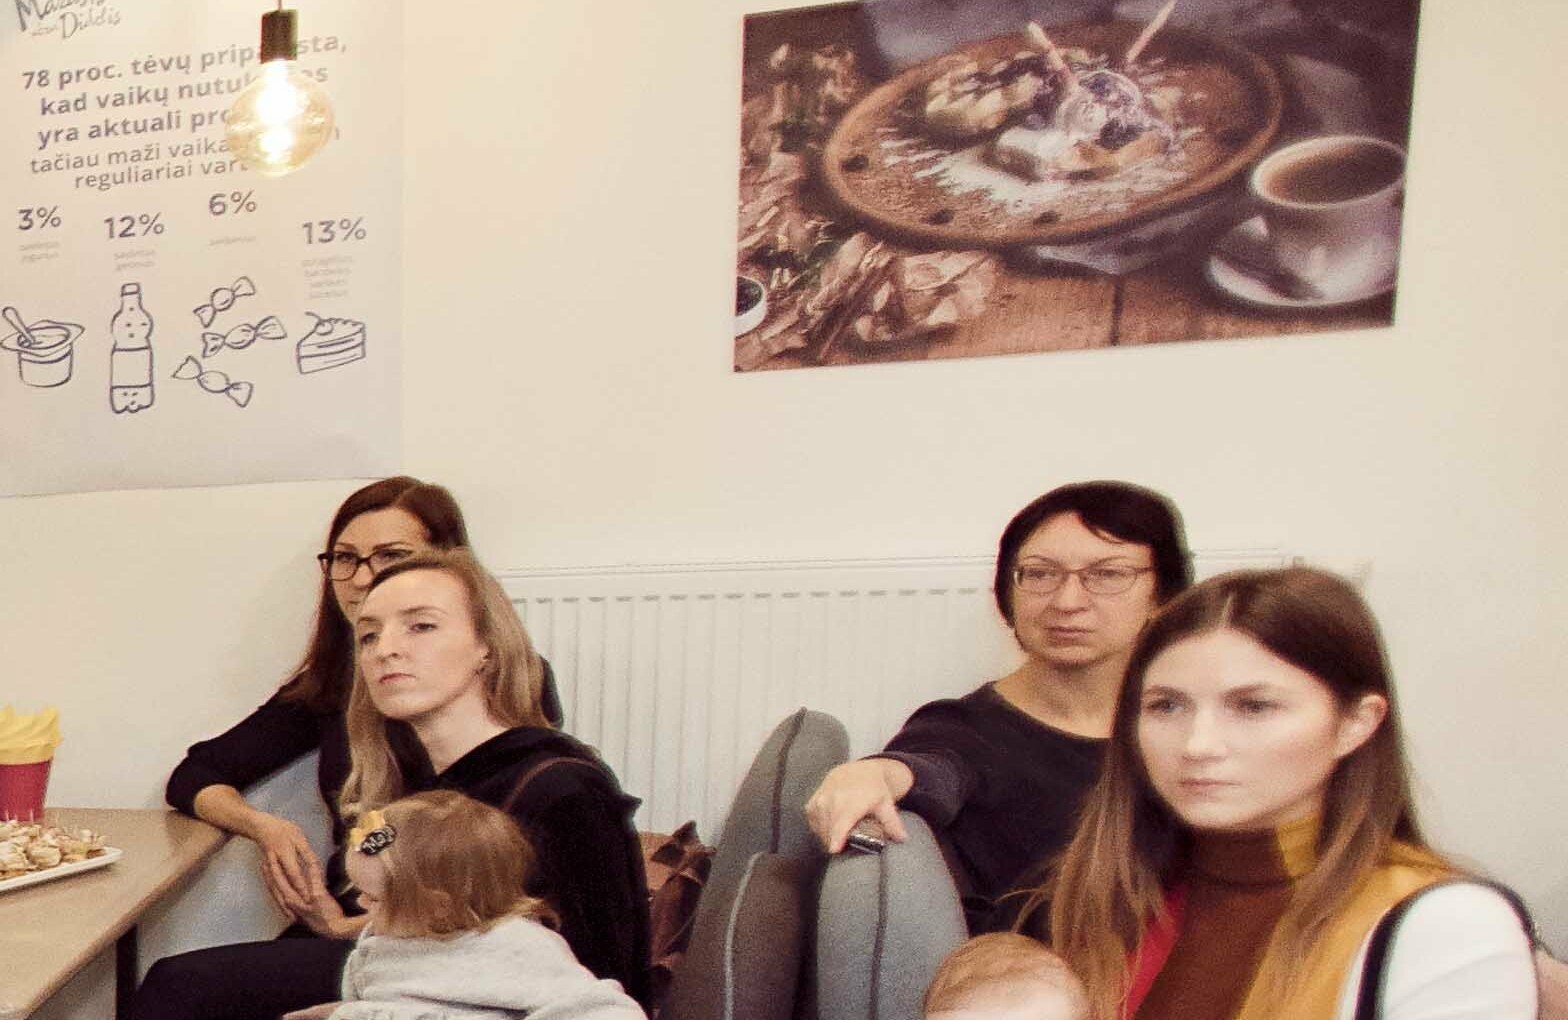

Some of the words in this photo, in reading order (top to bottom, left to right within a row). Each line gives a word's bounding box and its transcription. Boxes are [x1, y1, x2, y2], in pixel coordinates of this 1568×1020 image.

[22, 69, 49, 89] 78
[59, 61, 123, 90] proc.
[131, 54, 192, 75] tėvų
[200, 36, 347, 68] pripsta,
[40, 91, 88, 116] kad
[96, 84, 169, 107] vaikų
[37, 126, 80, 150] yra
[87, 110, 182, 140] aktuali
[30, 149, 99, 175] tačiau
[107, 142, 161, 166] maži
[168, 134, 234, 156] vaika
[74, 163, 193, 192] reguliariai
[17, 205, 62, 231] 3%
[208, 190, 258, 217] 6%
[103, 213, 165, 239] 12%
[301, 216, 368, 246] 13%
